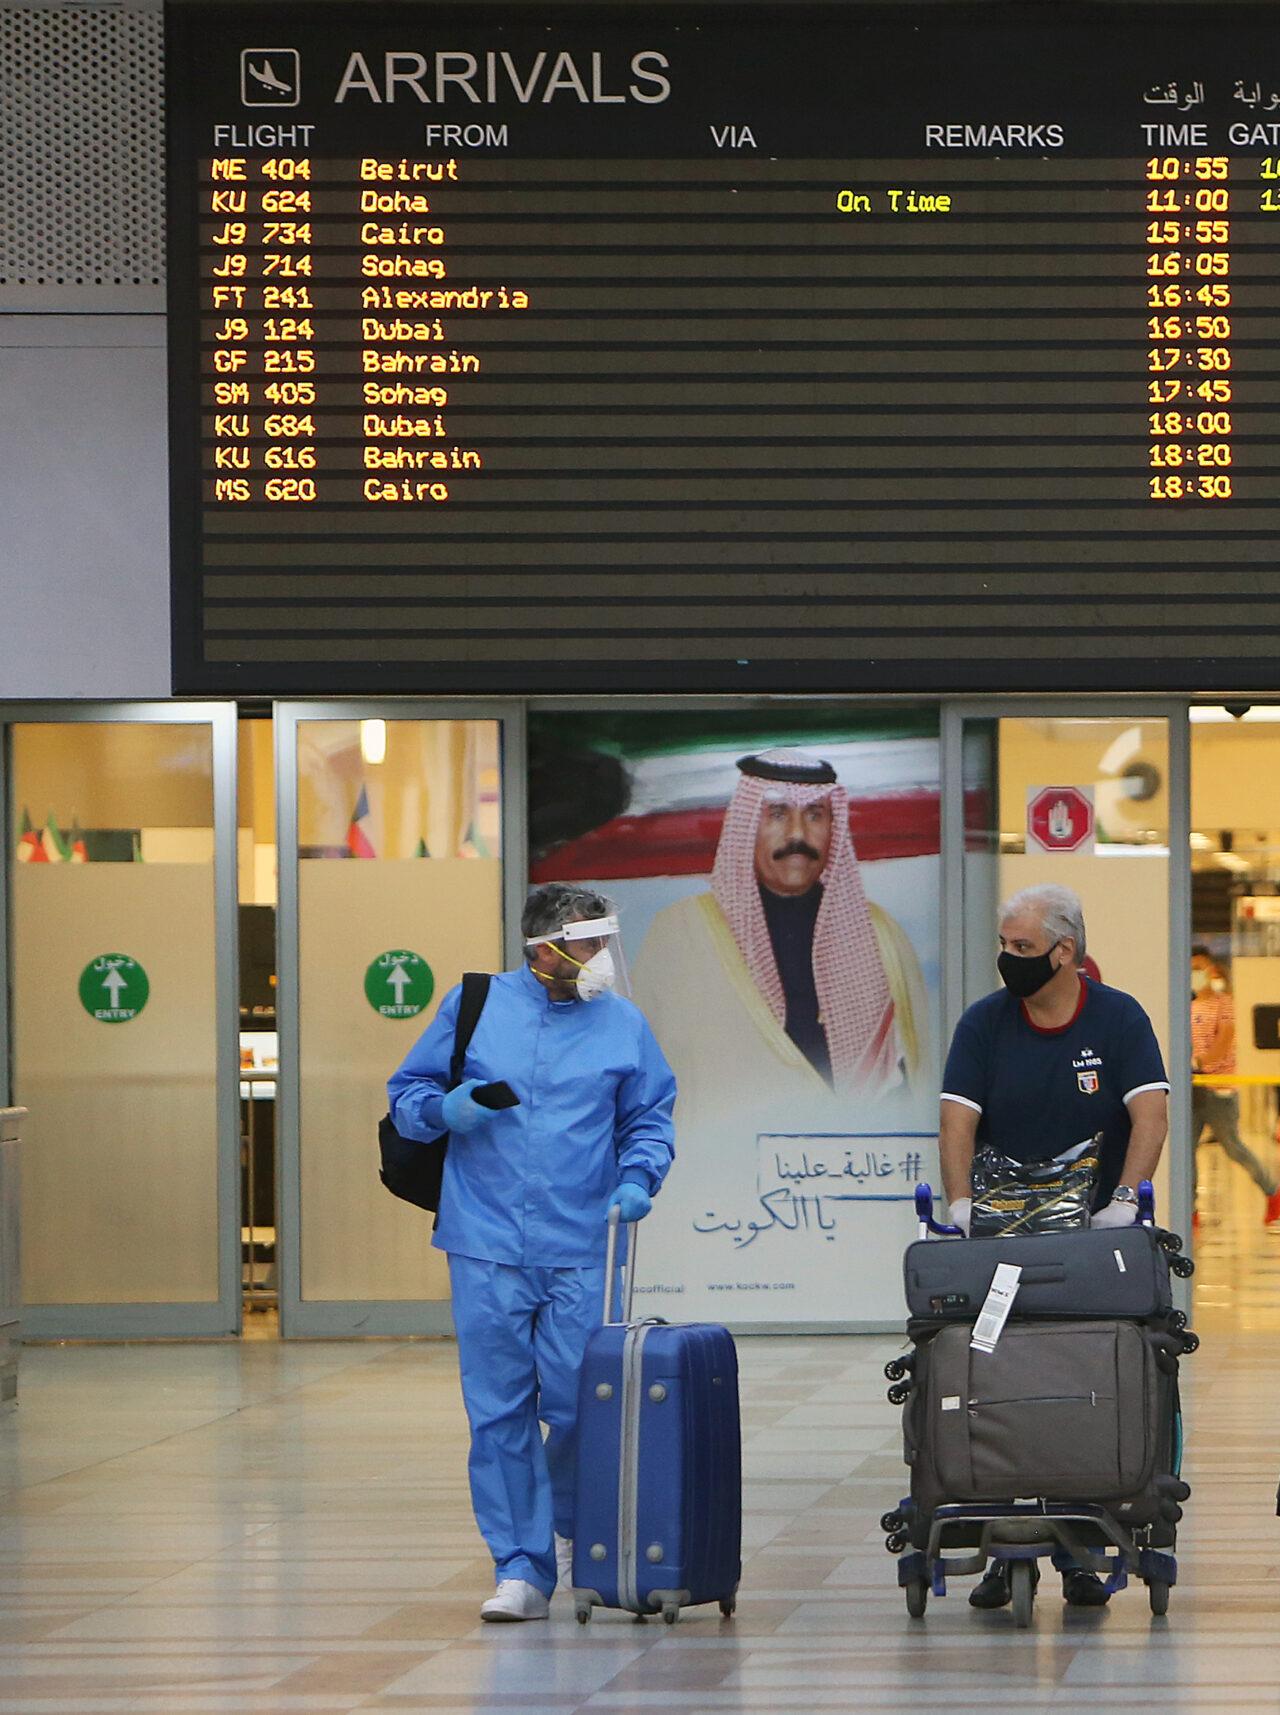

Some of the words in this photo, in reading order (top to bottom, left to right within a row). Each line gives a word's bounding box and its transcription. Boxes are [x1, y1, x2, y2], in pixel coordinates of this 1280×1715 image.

[334, 51, 671, 104] ARRIVALS
[1143, 81, 1204, 112] الوقت
[213, 125, 315, 147] FLIGHT
[426, 125, 508, 147] FROM
[710, 126, 758, 148] VIA
[925, 125, 1064, 147] REMARKS
[1140, 124, 1208, 147] TIME
[211, 158, 247, 181] ME
[262, 158, 311, 181] 404
[360, 158, 458, 181] Beirut
[1145, 156, 1230, 181] 10:55
[211, 190, 247, 213] KU
[262, 190, 312, 213] 624
[360, 190, 429, 213] Doha
[836, 190, 872, 213] On
[887, 190, 951, 212] Time
[1146, 188, 1229, 213] 11:00
[212, 222, 248, 245] J9
[263, 222, 312, 245] 734
[360, 222, 444, 245] Cairo
[1146, 220, 1230, 244] 15:55
[212, 254, 248, 277] J9
[263, 254, 313, 277] 714
[361, 254, 446, 280] Sohag
[1146, 252, 1230, 276] 16:05
[212, 285, 248, 309] FT
[263, 285, 314, 309] 241
[361, 286, 529, 309] Alexandria
[1147, 284, 1231, 308] 16:45
[213, 318, 249, 341] J9
[264, 318, 315, 341] 124
[362, 318, 445, 341] Dubai
[1147, 315, 1231, 339] 16:50
[213, 349, 249, 373] GF
[264, 349, 316, 373] 215
[362, 349, 480, 373] Bahrain
[1147, 347, 1232, 372] 17:30
[213, 382, 249, 405] SM
[264, 382, 316, 405] 405
[363, 382, 448, 407] Sohag
[1147, 379, 1232, 403] 17:45
[214, 414, 250, 437] KU
[265, 414, 317, 437] 684
[363, 414, 446, 437] Dubai
[1148, 411, 1232, 435] 18:00
[214, 446, 250, 469] KU
[265, 446, 317, 469] 616
[363, 446, 481, 469] Bahrain
[1150, 443, 1232, 467] 18:20
[215, 478, 251, 501] MS
[266, 478, 317, 501] 620
[363, 478, 449, 501] Cairo
[1149, 475, 1232, 499] 18:30
[94, 956, 135, 972] دخول
[379, 951, 419, 967] دخول
[94, 1008, 136, 1019] ENTRY
[379, 1004, 420, 1015] ENTRY
